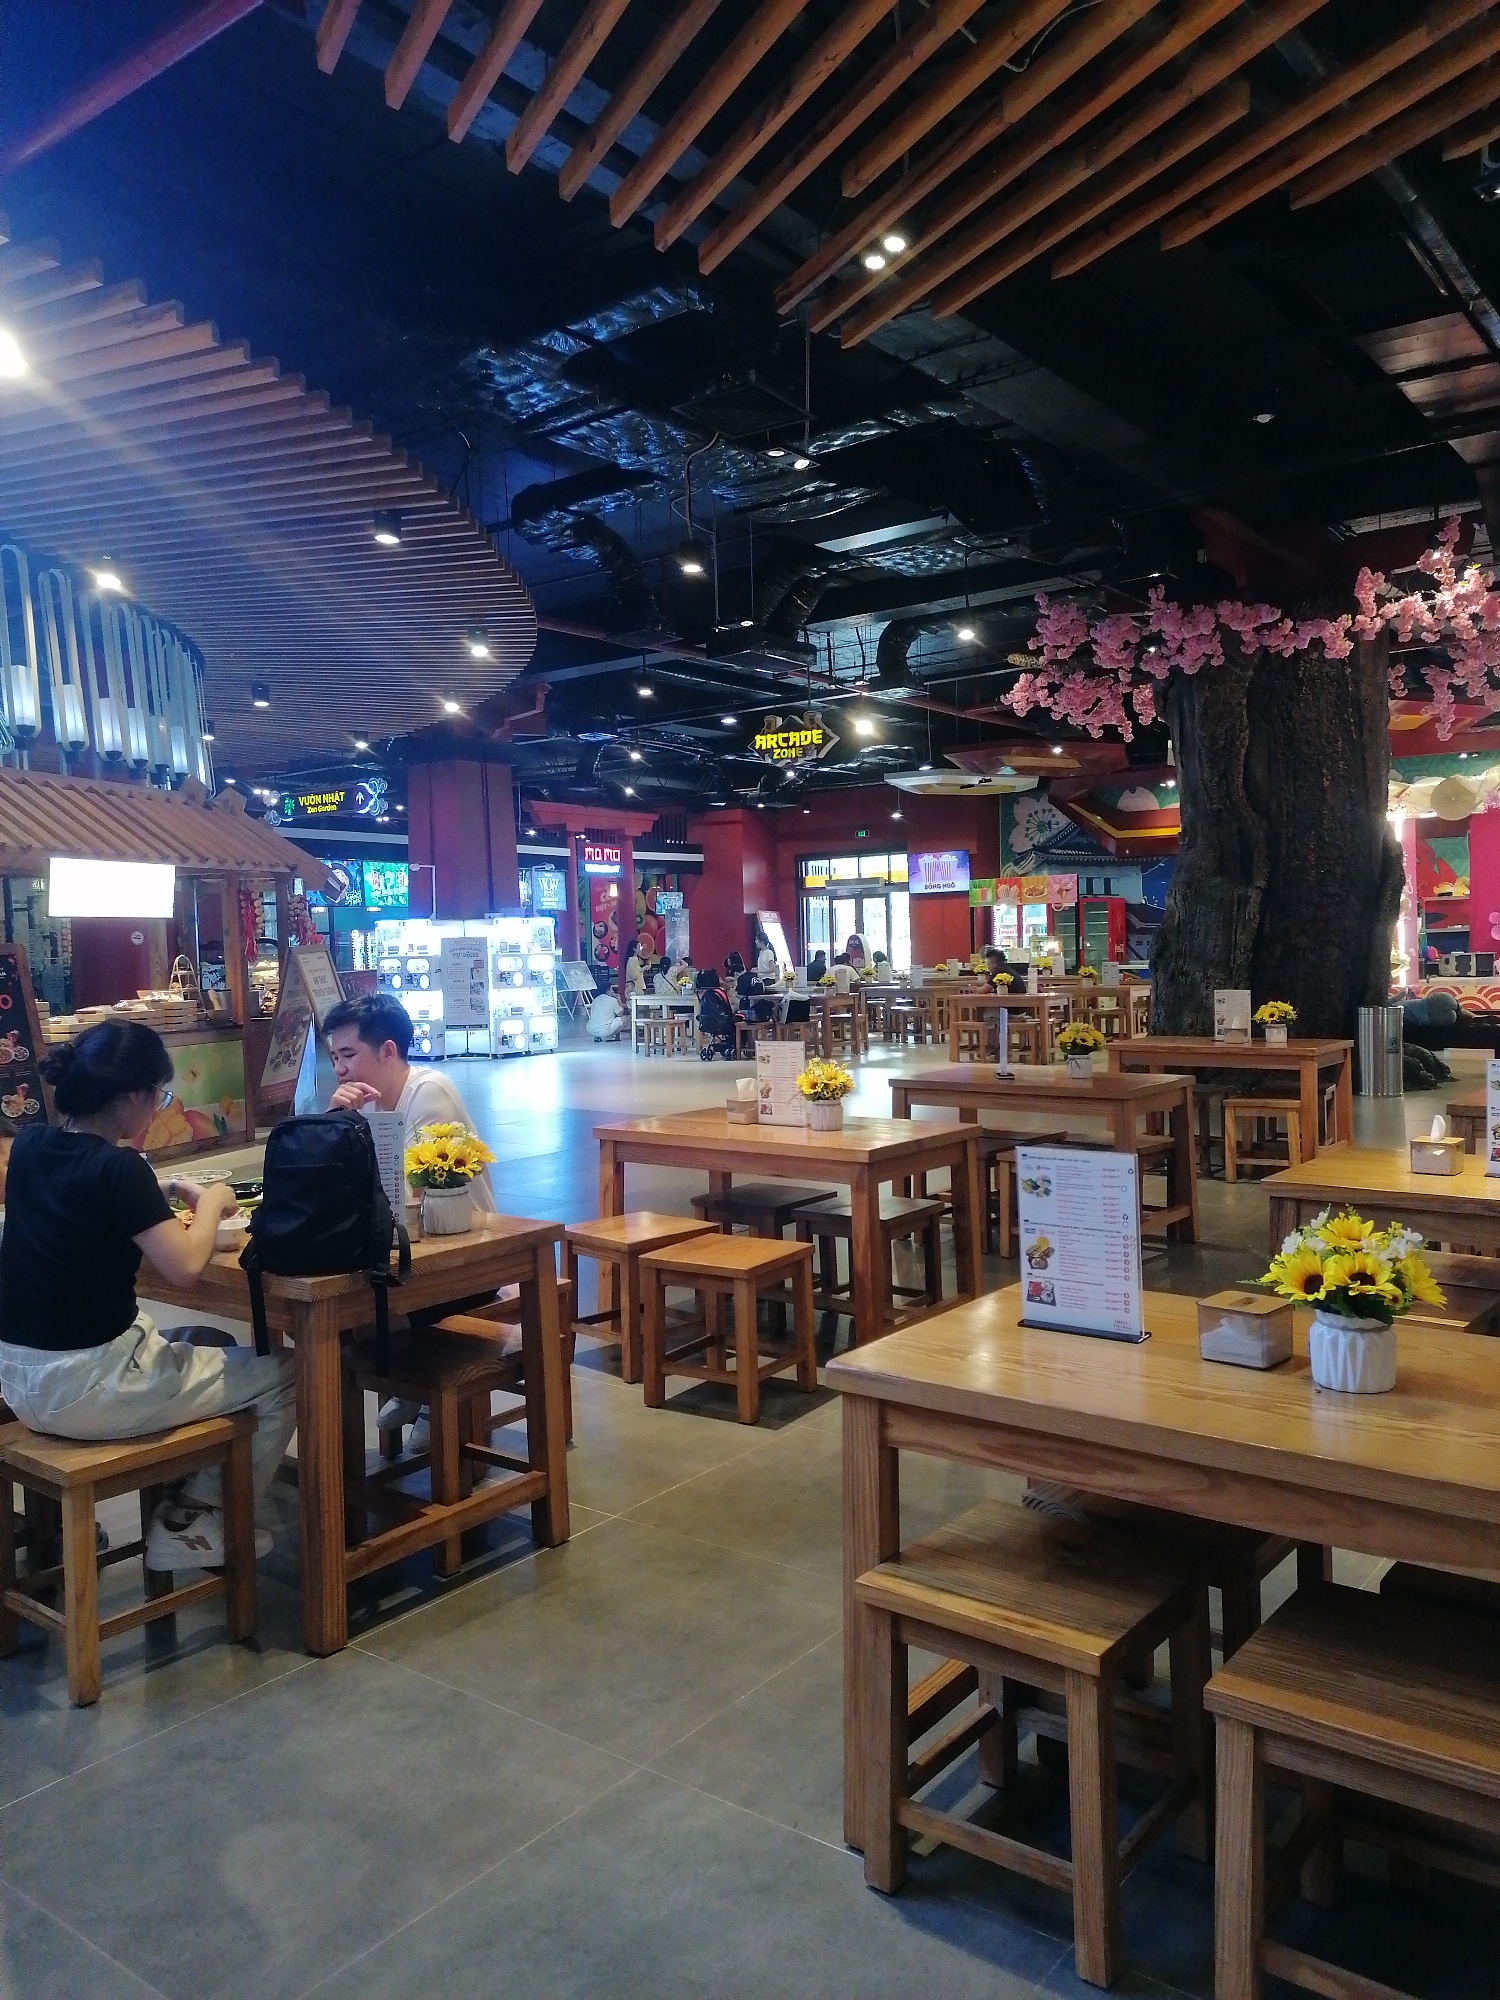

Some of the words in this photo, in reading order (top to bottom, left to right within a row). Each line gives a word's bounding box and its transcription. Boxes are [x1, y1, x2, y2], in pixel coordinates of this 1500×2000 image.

[754, 729, 824, 751] ARCADE
[773, 747, 803, 759] ZONE
[322, 790, 345, 805] NHẬT
[306, 806, 318, 814] Zen
[318, 804, 337, 813] Garden
[942, 881, 955, 889] NGÔ
